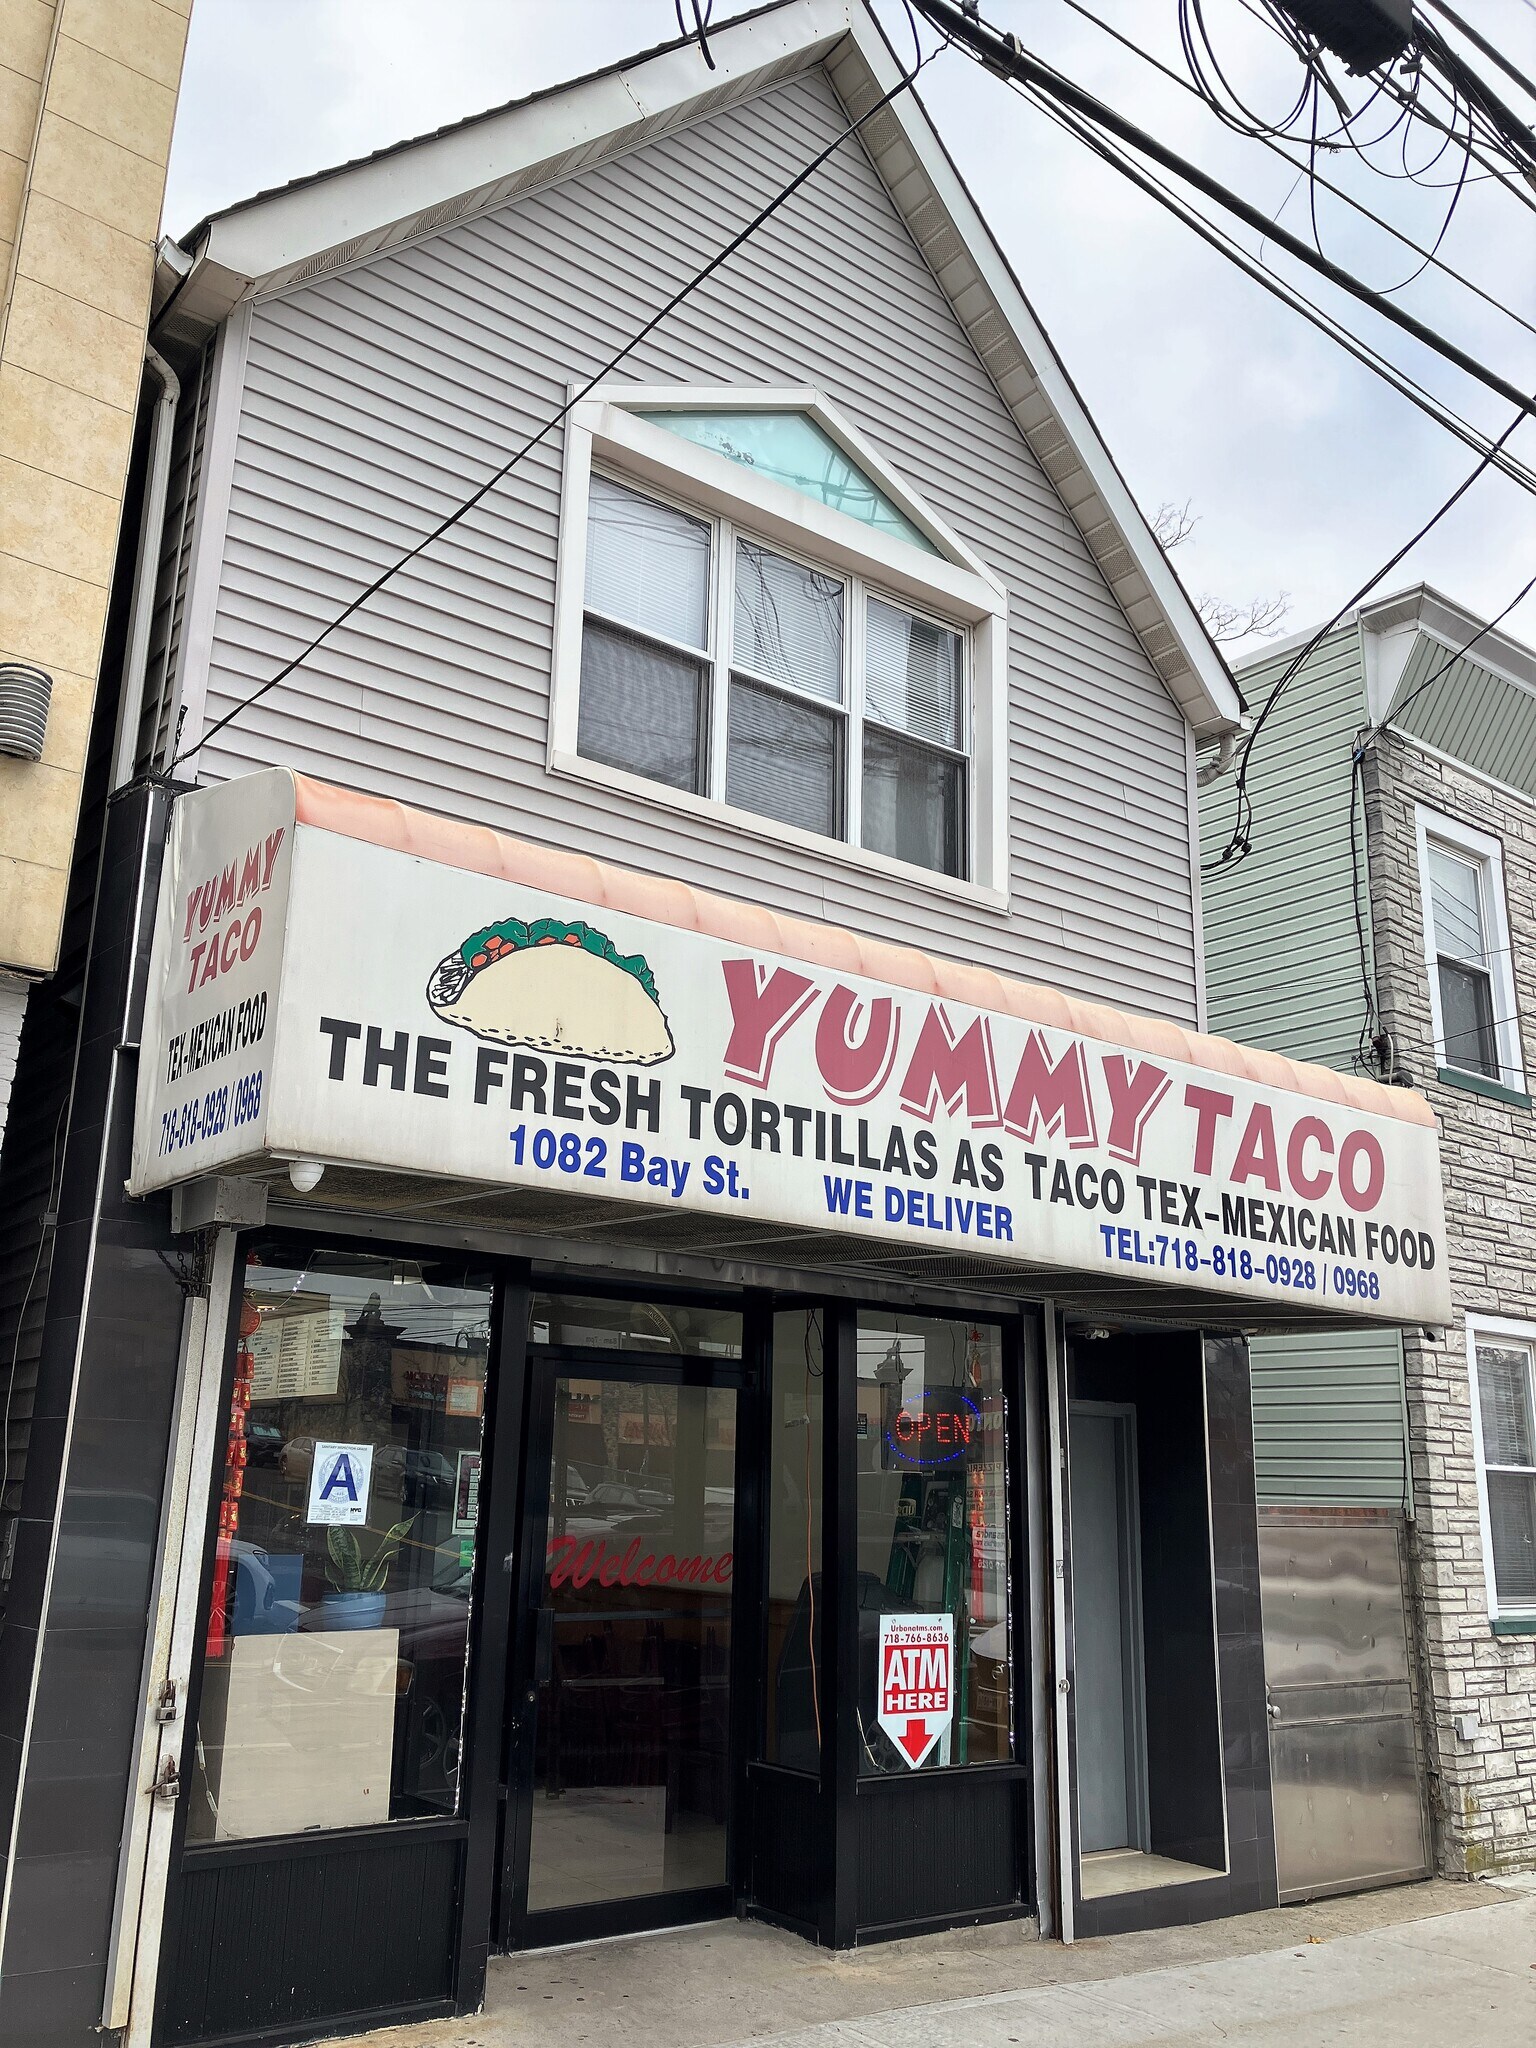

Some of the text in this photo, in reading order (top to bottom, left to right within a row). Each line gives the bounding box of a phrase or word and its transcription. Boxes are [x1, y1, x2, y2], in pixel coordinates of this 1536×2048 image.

[183, 828, 286, 944] YUMMY
[187, 907, 263, 995] TACO
[166, 991, 268, 1084] TEX-MEXICAN FOOD
[158, 1088, 228, 1157] 718-818-0928
[234, 1070, 264, 1129] 0968
[721, 959, 1386, 1212] YUMMY TACO
[319, 1016, 1437, 1271] THE FRESH TORTILLAS AS TACO TEX-MEXICAN FOOD
[509, 1124, 749, 1200] 1082 Bay St.
[824, 1174, 1014, 1242] WE DELIVER
[1100, 1224, 1317, 1290] TEL:718-818-0928
[1333, 1265, 1380, 1300] 0968
[896, 1410, 970, 1444] OPEN
[319, 1454, 358, 1501] A
[546, 1535, 733, 1589] Welcome
[883, 1633, 949, 1643] 718-766-8636
[884, 1648, 947, 1691] ATM
[886, 1691, 946, 1711] HERE
